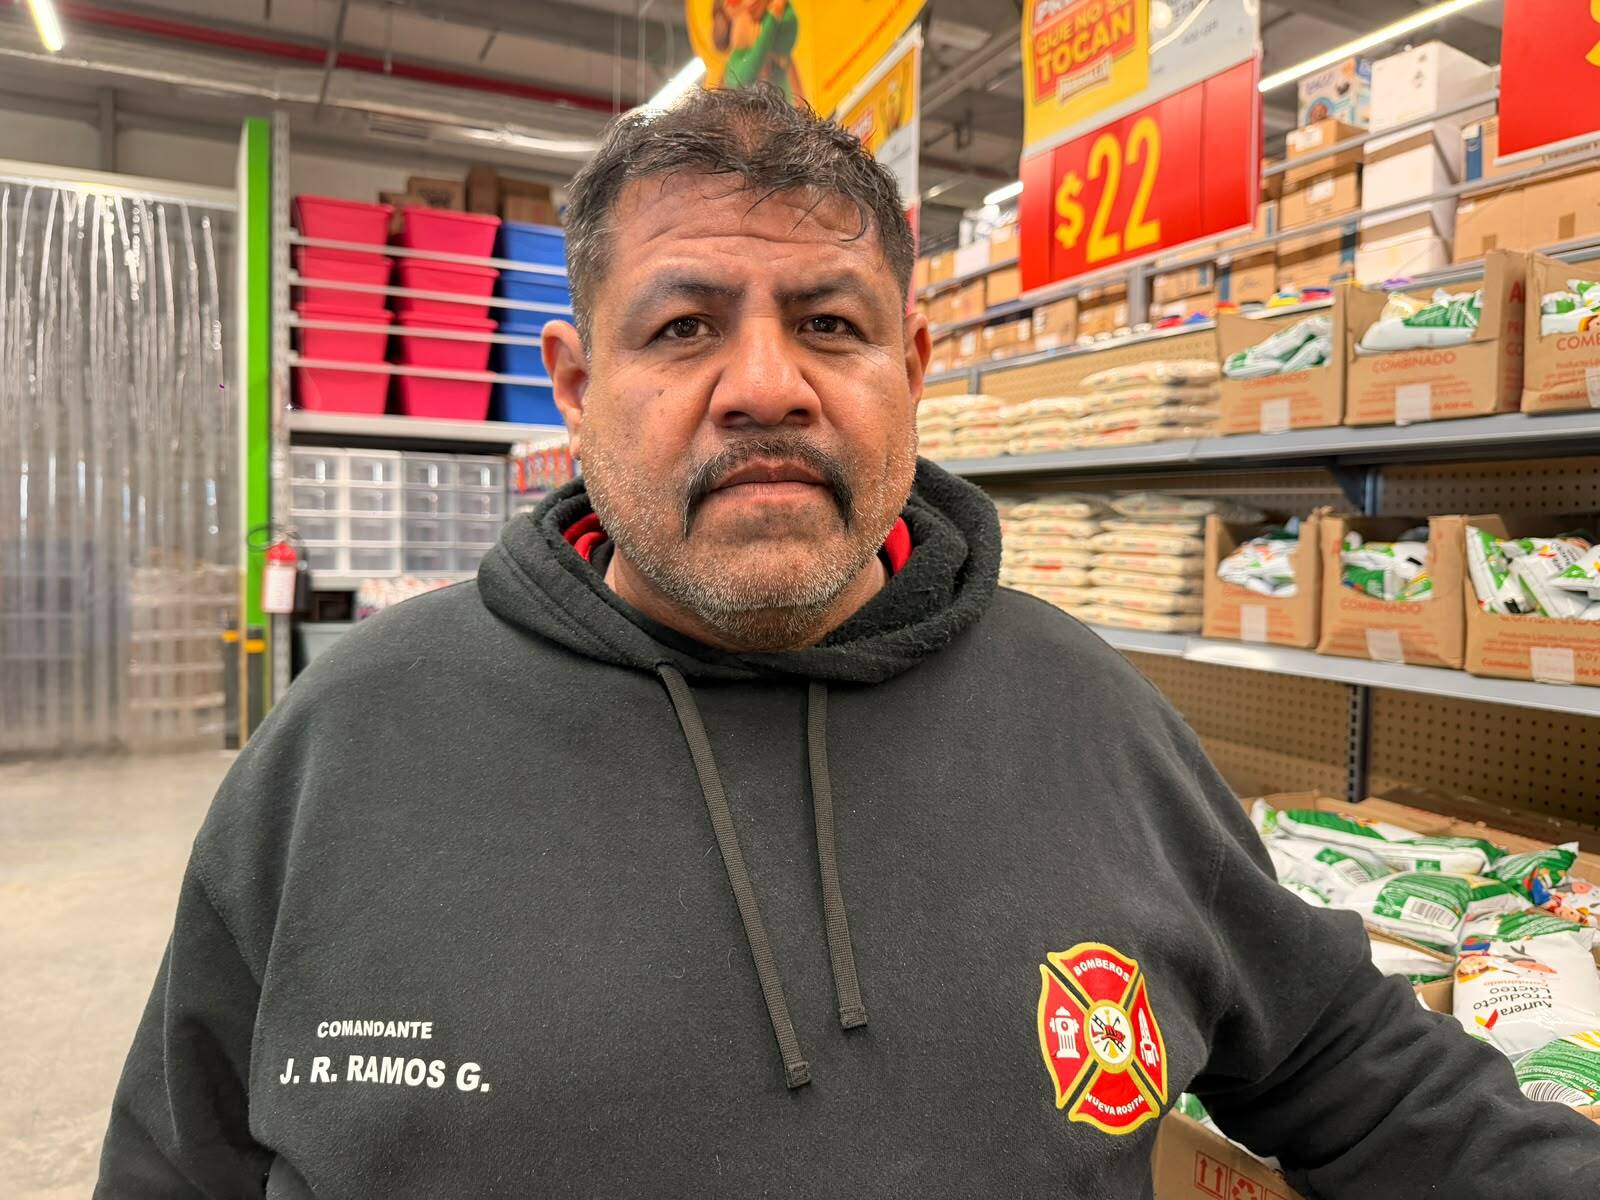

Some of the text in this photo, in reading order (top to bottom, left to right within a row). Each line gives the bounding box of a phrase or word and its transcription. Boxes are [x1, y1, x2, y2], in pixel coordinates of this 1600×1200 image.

[1037, 23, 1074, 56] QUE
[1075, 2, 1104, 32] NO
[1037, 5, 1132, 84] TOCAN
[1055, 116, 1162, 263] $22
[1372, 351, 1456, 373] COMBINADO
[1073, 958, 1130, 982] BOMBEROS
[1500, 1000, 1552, 1016] Aurrera
[317, 1020, 433, 1039] COMANDANTE
[279, 1054, 490, 1092] J. R. RAMOS G.
[1085, 1093, 1145, 1115] NUEVA ROSITA
